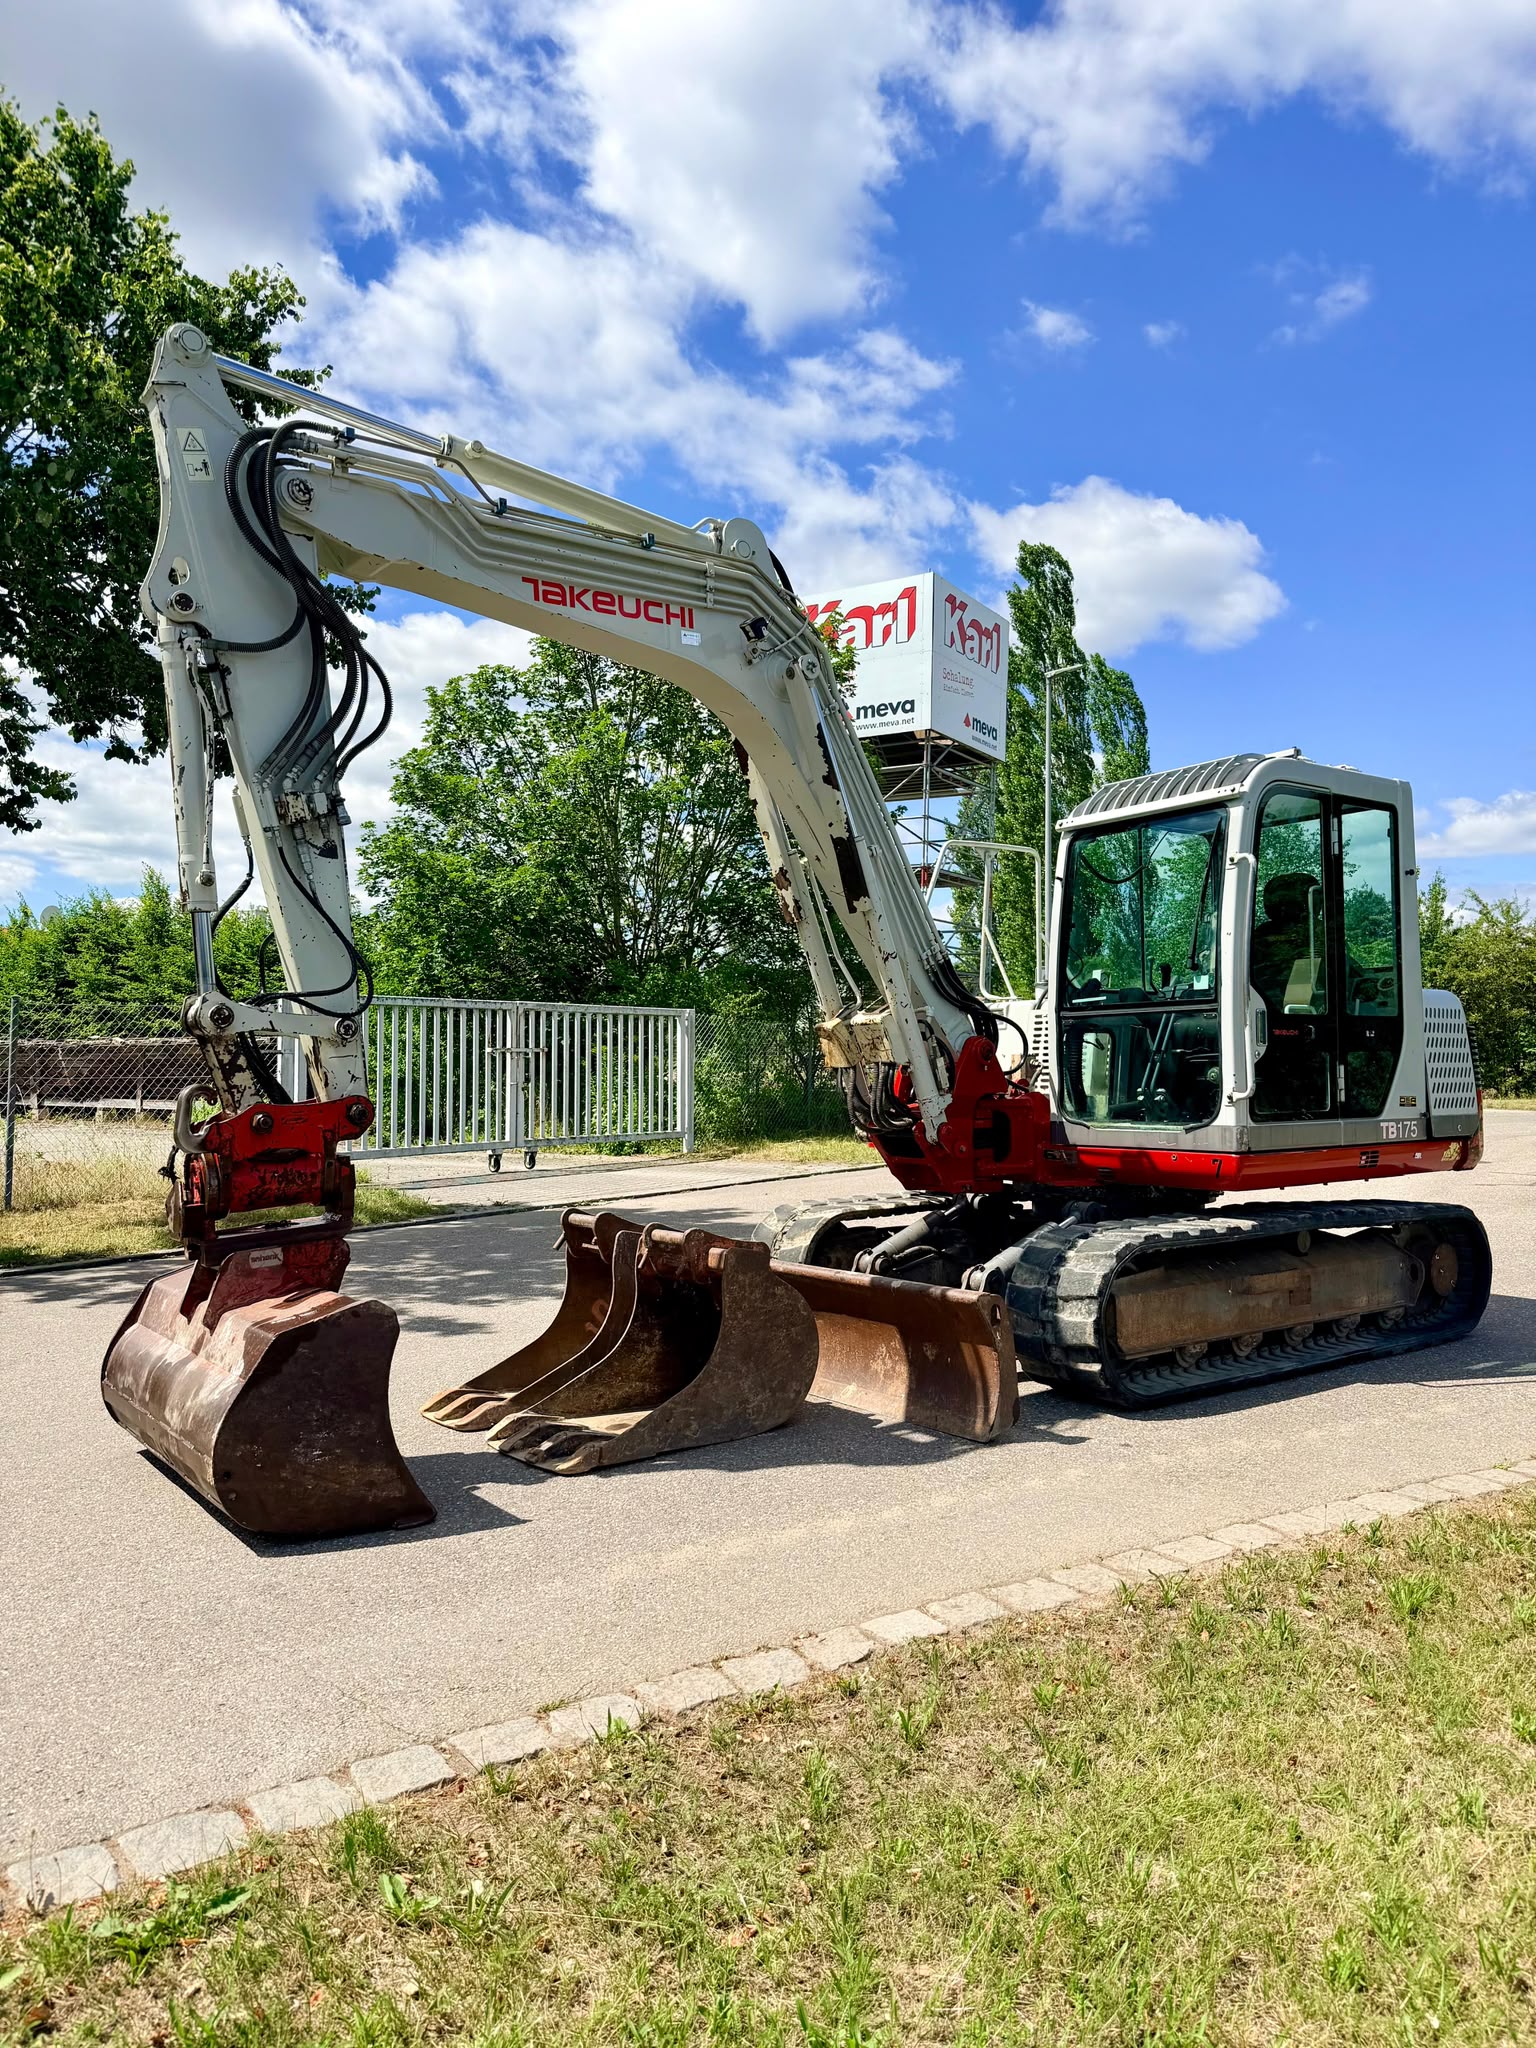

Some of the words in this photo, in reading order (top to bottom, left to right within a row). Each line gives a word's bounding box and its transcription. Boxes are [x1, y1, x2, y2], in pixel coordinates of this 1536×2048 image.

[521, 576, 694, 629] TAKEUCHI
[943, 593, 1001, 674] Karl
[856, 699, 915, 720] meva
[855, 717, 915, 731] www.meva.net
[972, 716, 998, 741] meva
[1380, 1121, 1418, 1139] TB175
